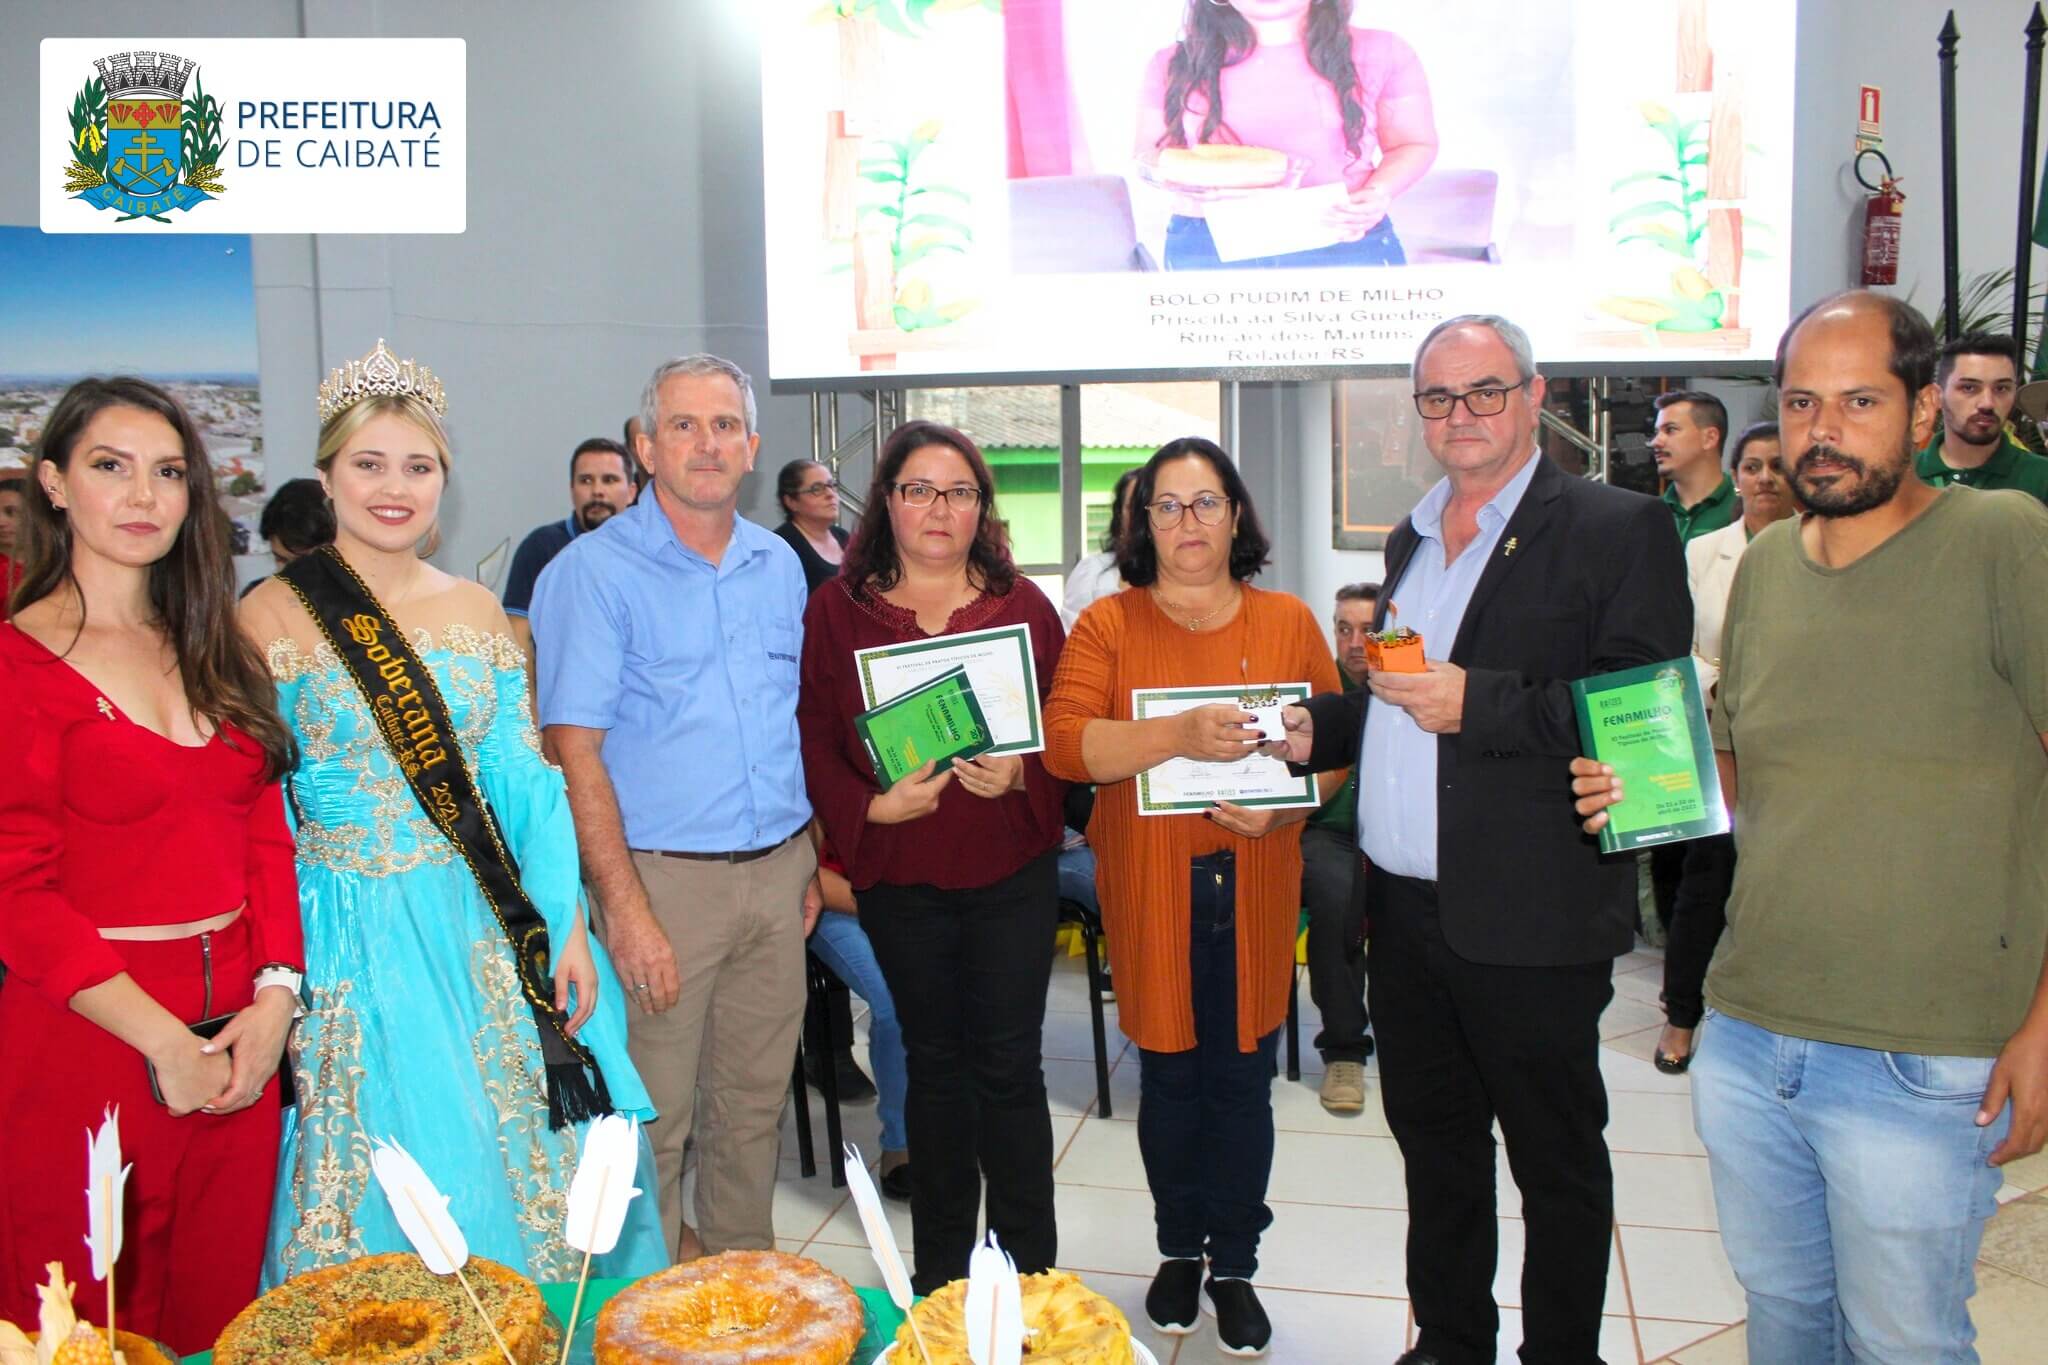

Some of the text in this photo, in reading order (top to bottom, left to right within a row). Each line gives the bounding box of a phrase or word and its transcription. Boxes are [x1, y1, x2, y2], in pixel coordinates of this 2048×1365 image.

[1150, 288, 1444, 306] BOLO PUDIM DE MILHO
[1151, 312, 1238, 326] Priscila
[1283, 311, 1341, 323] Silva
[1350, 309, 1443, 321] Guedes
[1324, 329, 1413, 340] Martins
[341, 614, 448, 770] Soberana
[936, 694, 961, 741] FENAMILHO
[1603, 705, 1672, 727] FENAMILHO
